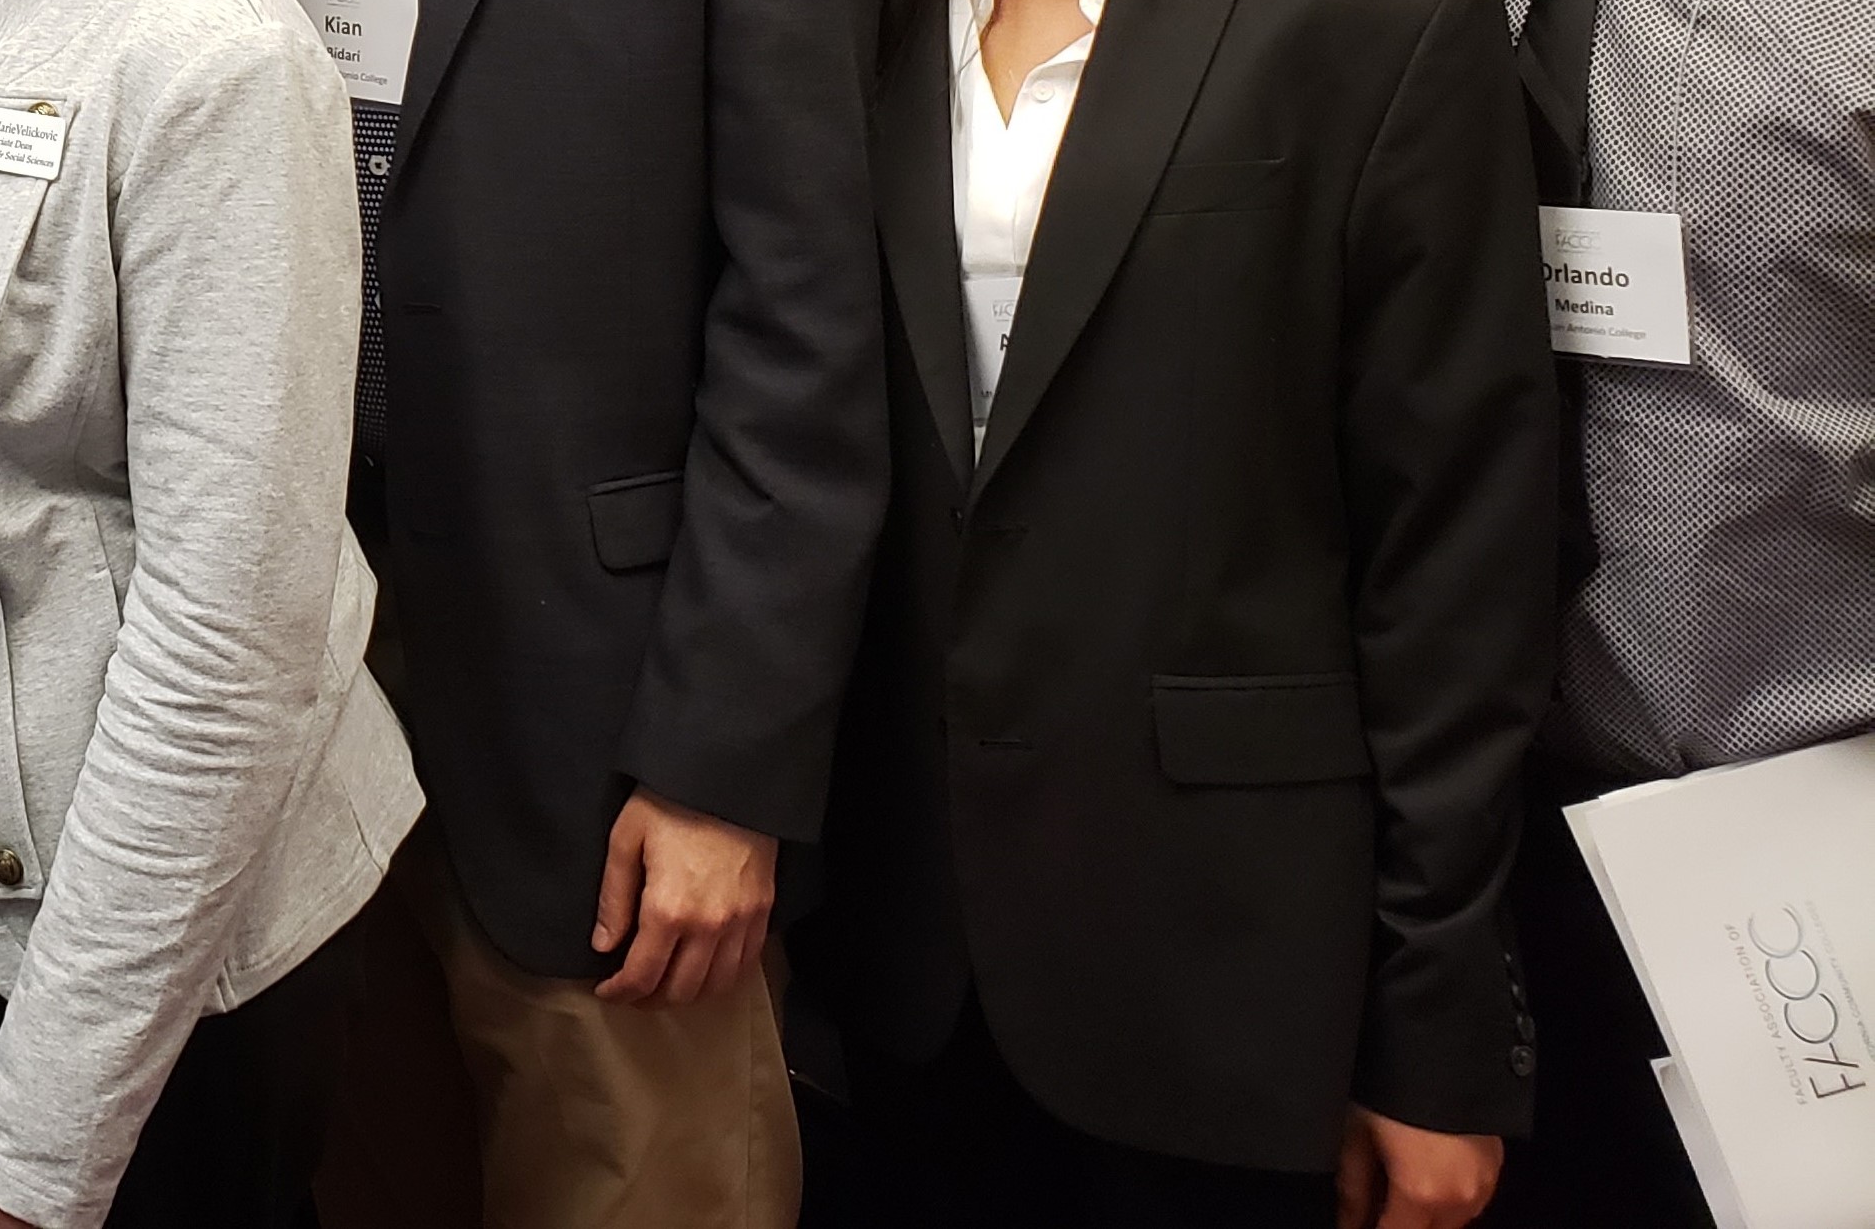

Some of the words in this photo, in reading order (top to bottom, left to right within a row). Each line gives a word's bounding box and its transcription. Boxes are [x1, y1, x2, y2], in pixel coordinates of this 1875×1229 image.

[325, 15, 362, 36] Kian
[14, 139, 33, 151] Dean
[5, 151, 25, 162] Social
[26, 155, 54, 168] Sciences
[1542, 262, 1630, 288] Orlando
[1555, 299, 1614, 315] Medina
[1724, 924, 1740, 941] OF
[1736, 946, 1782, 1039] ASSOCIATION
[1748, 901, 1867, 1099] FACCC
[1776, 1045, 1807, 1106] FACULTY
